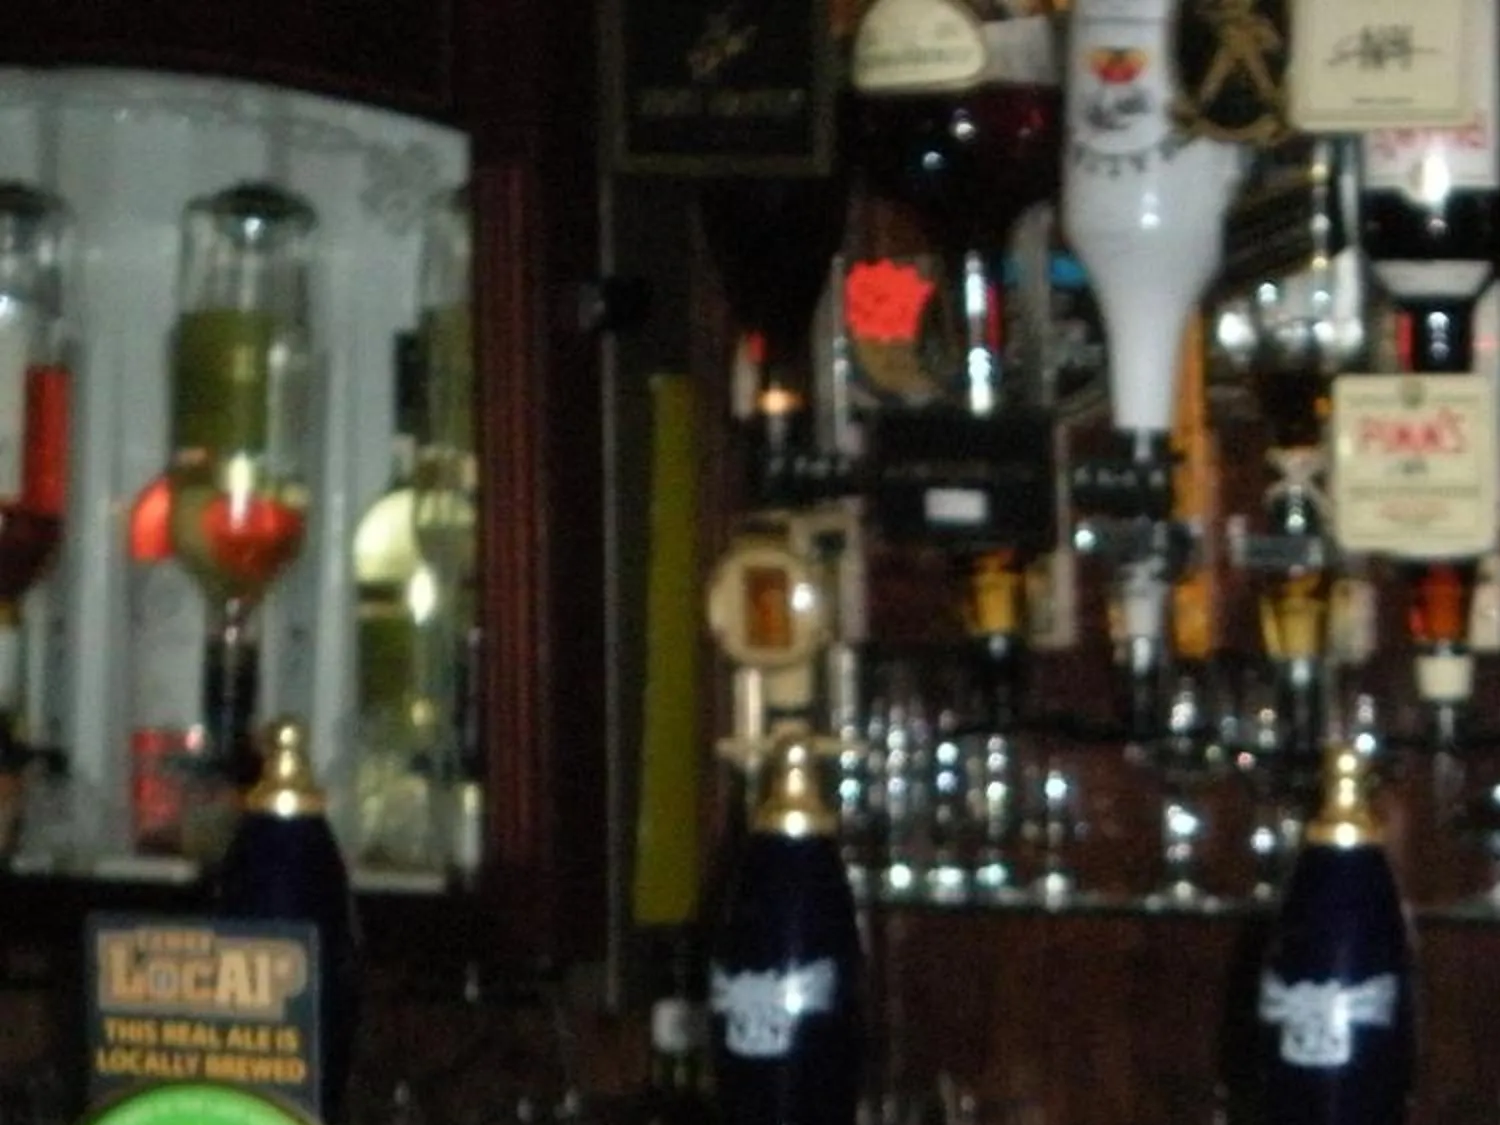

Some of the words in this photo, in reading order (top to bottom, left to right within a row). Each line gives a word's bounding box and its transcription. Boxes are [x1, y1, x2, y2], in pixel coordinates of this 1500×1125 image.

[227, 1024, 272, 1051] ALE
[97, 1048, 199, 1076] LOCALLY
[204, 1053, 307, 1083] BREWED
